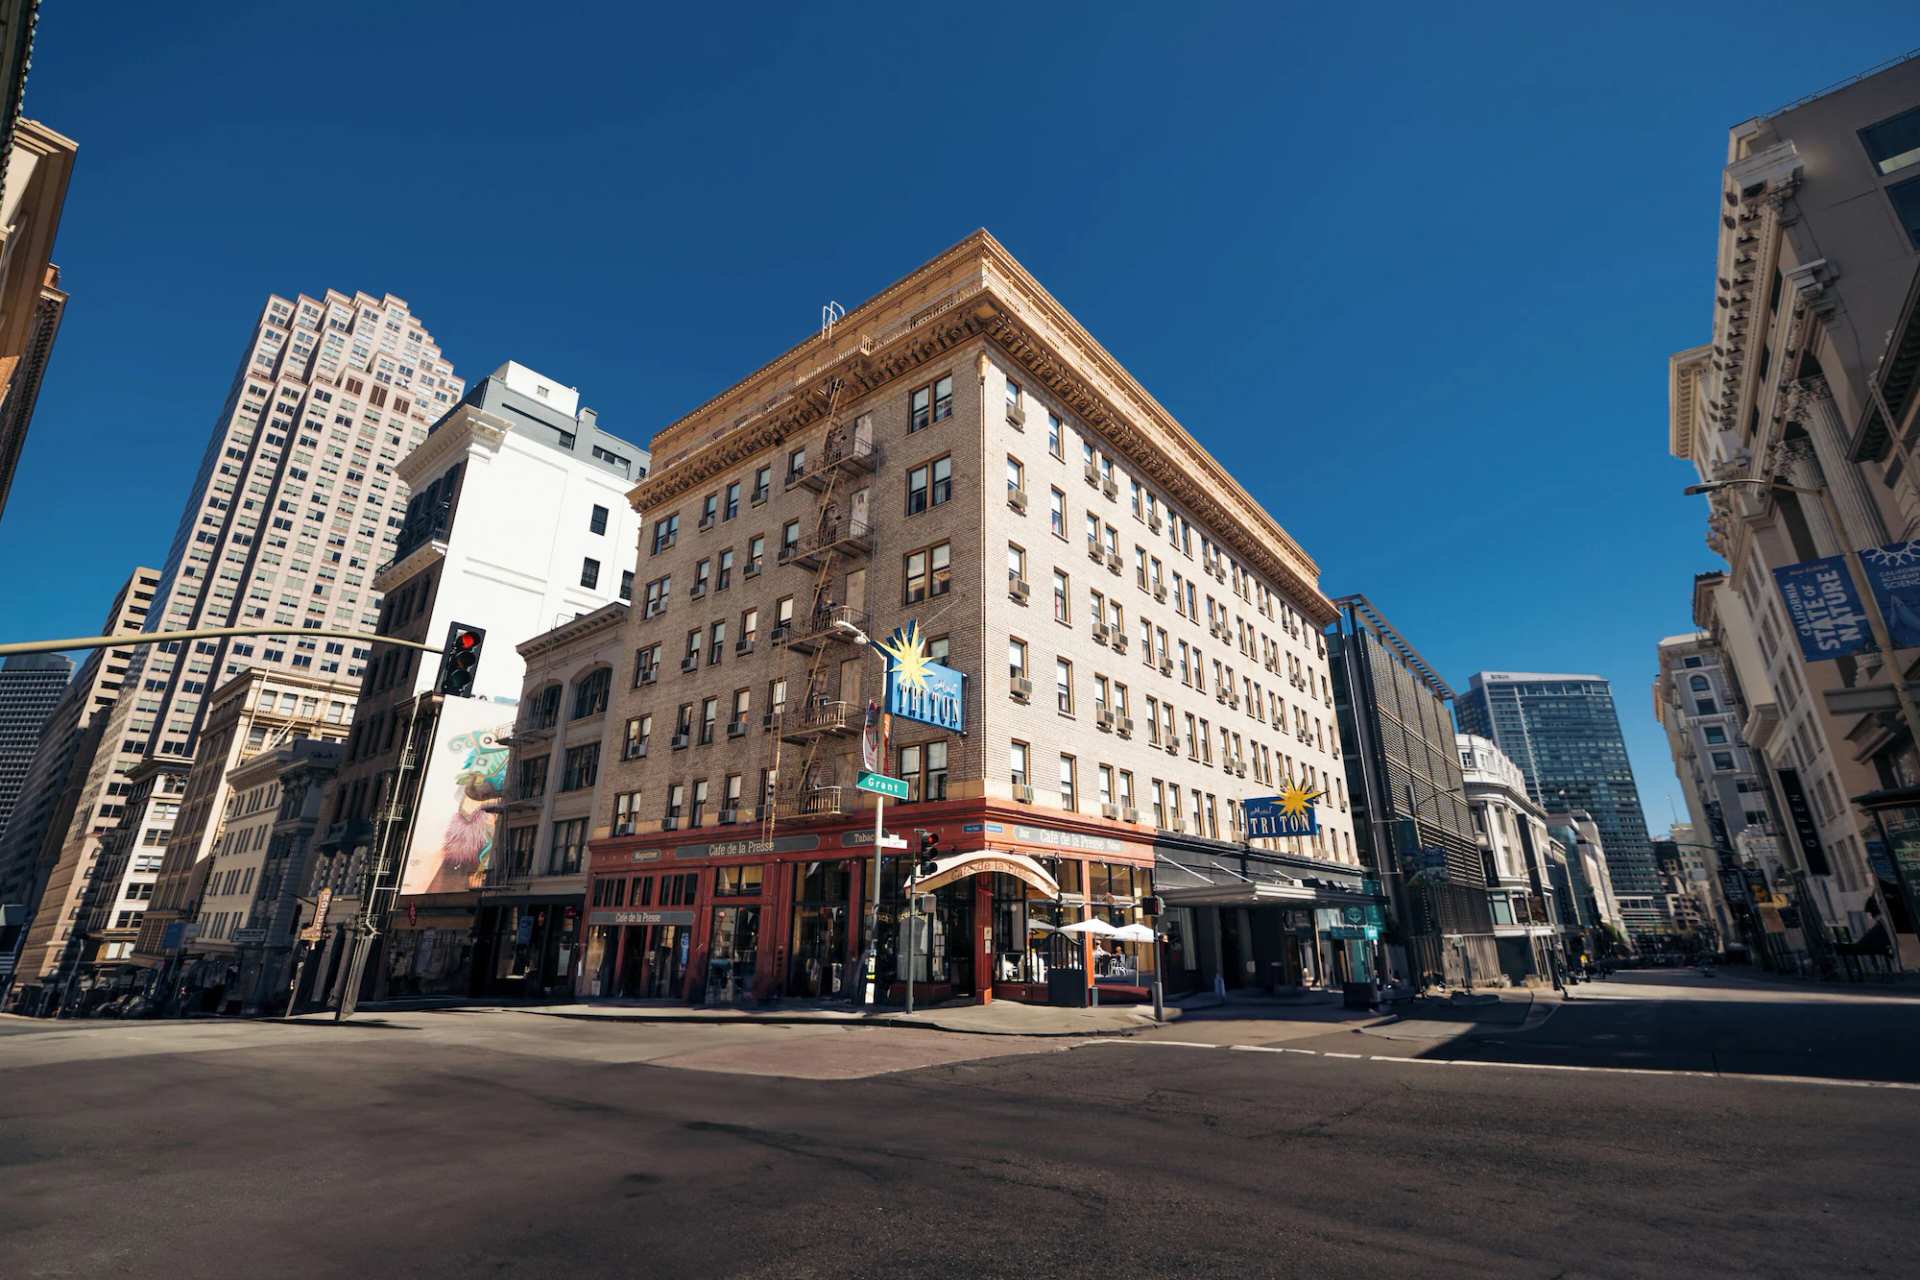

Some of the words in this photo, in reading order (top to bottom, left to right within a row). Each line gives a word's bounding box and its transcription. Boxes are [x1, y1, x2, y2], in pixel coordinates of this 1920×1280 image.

[1802, 585, 1817, 597] OF
[1784, 582, 1812, 636] CALIFORNIA
[1816, 570, 1867, 642] NATURE
[1804, 597, 1841, 651] STATE
[868, 777, 898, 793] Grant
[1250, 814, 1311, 835] TRITON
[727, 844, 737, 855] de
[738, 842, 747, 854] la
[748, 839, 775, 853] Presse
